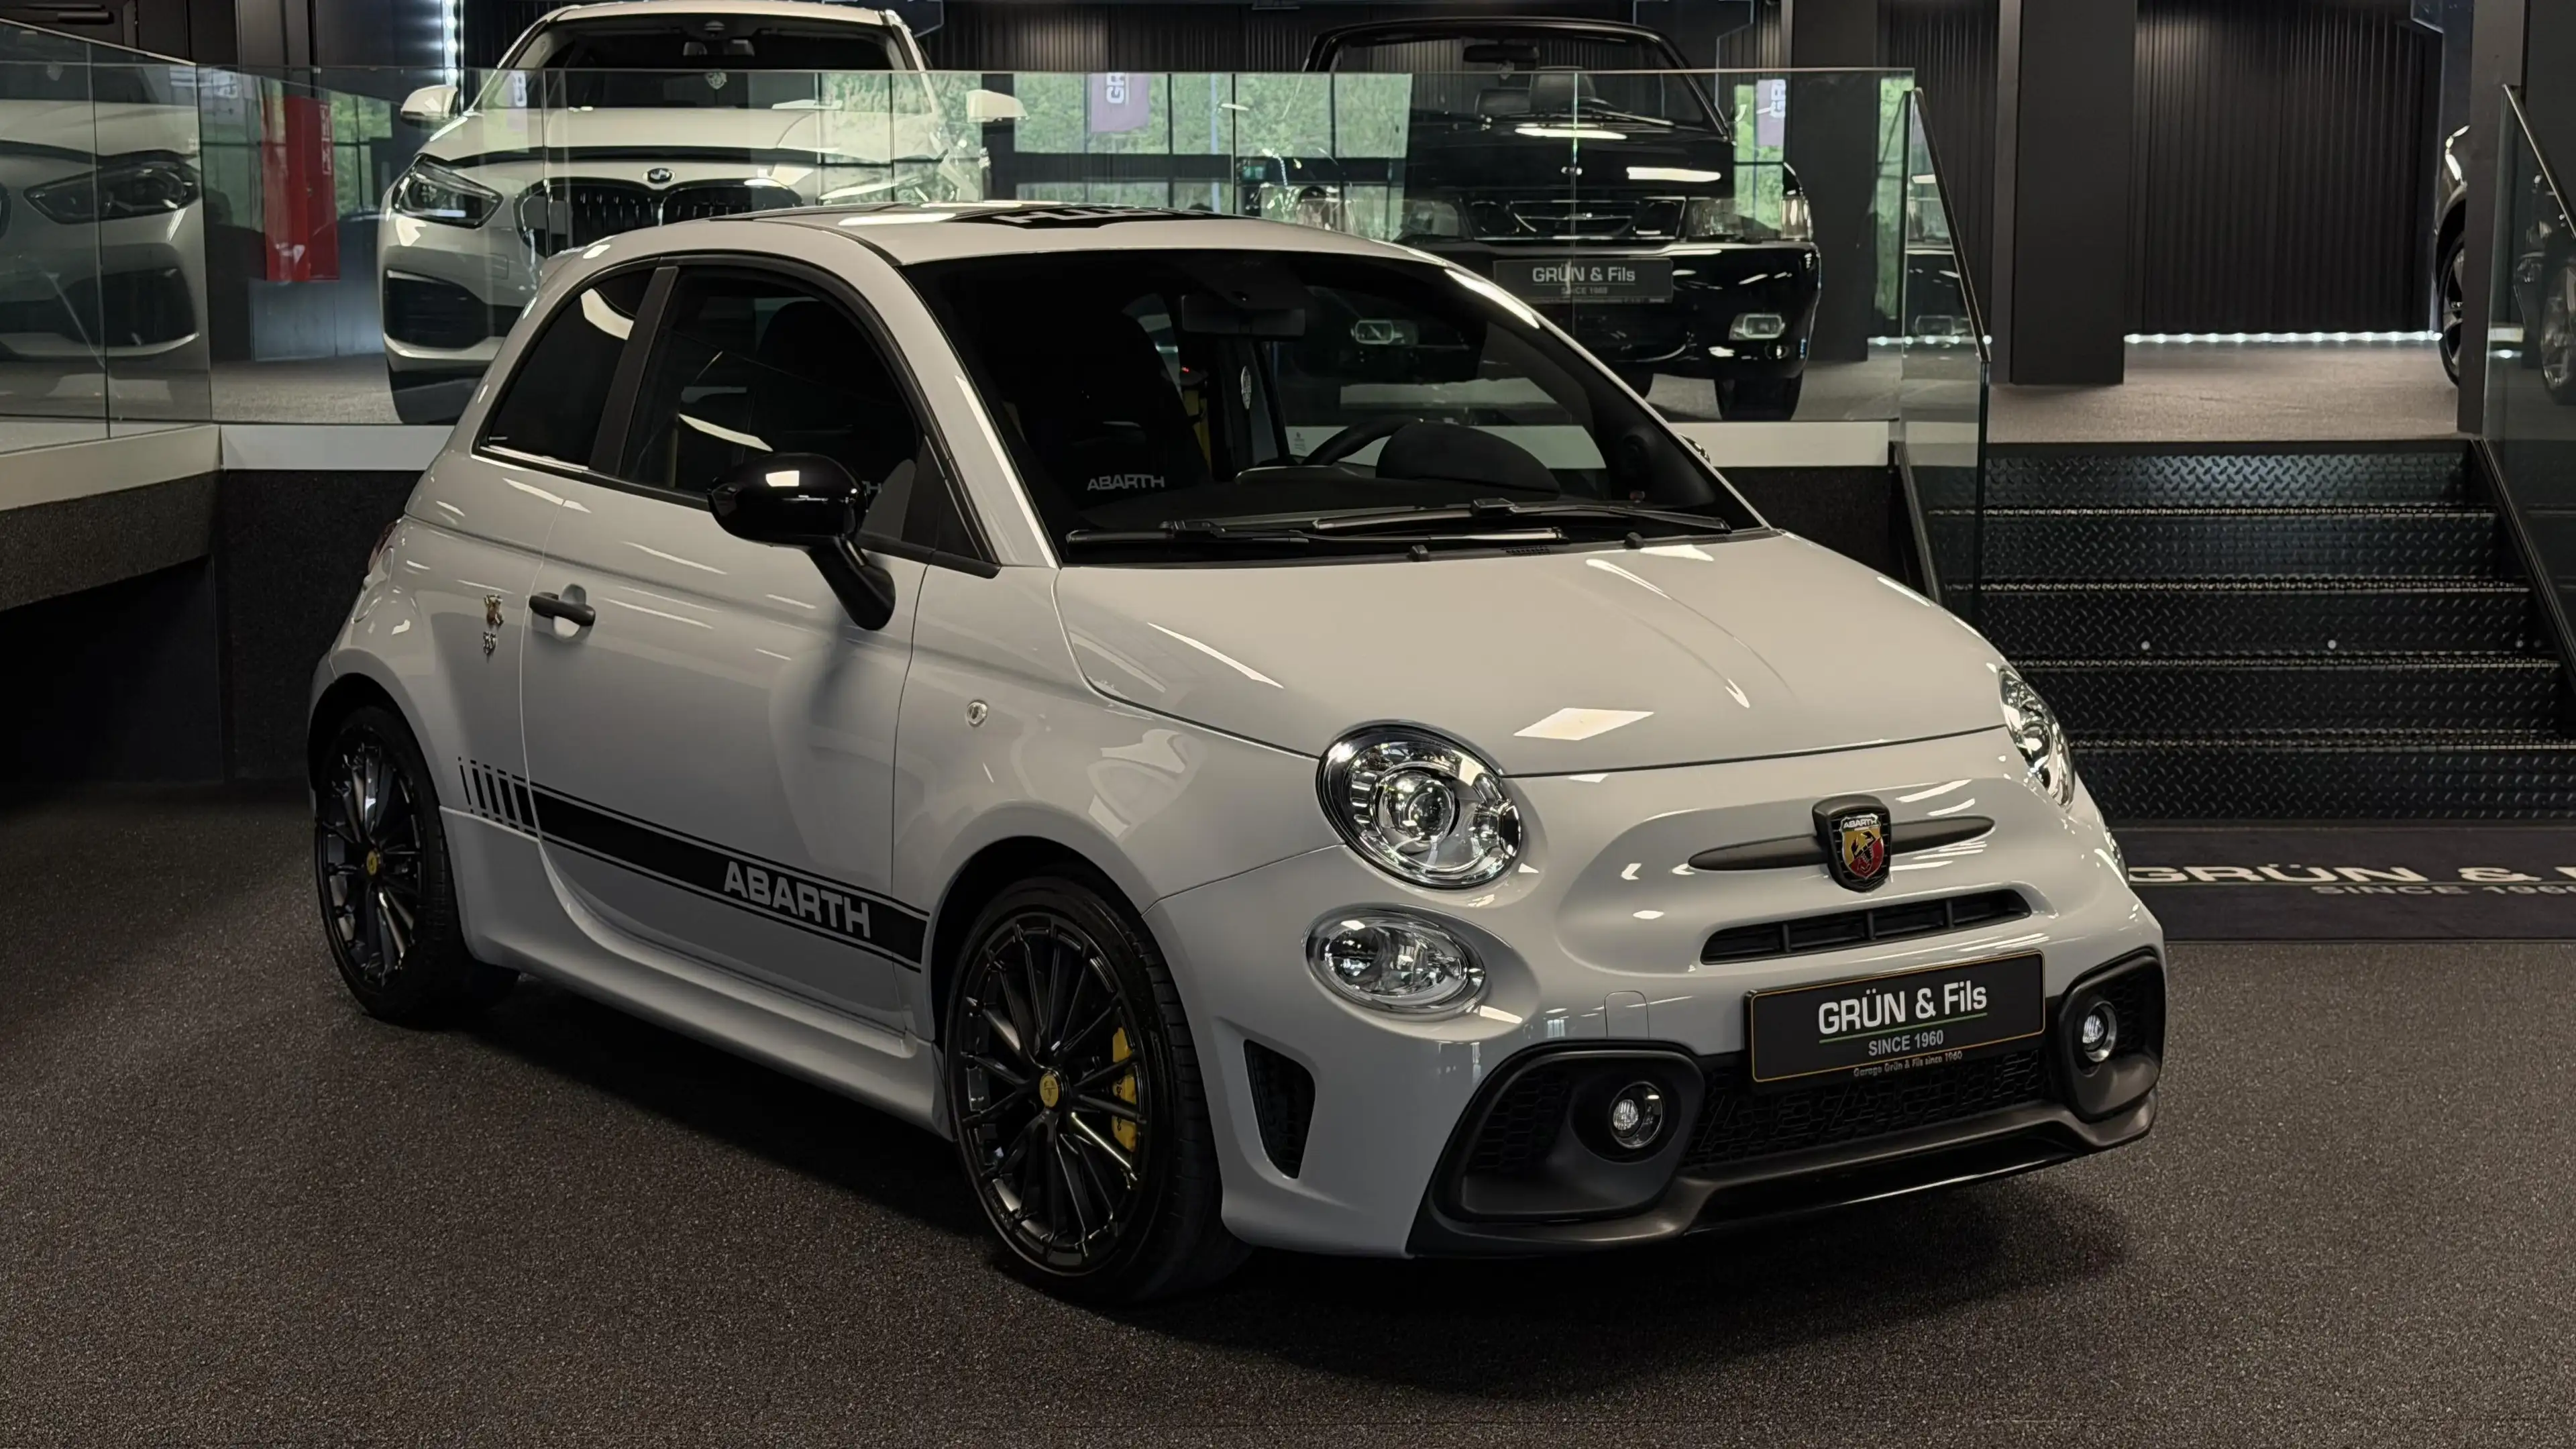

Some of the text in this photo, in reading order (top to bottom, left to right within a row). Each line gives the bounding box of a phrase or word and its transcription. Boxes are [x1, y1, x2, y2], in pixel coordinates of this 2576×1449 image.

[1532, 264, 1635, 282] GRÜN & Fils
[1087, 474, 1165, 491] ABARTH
[1843, 818, 1878, 828] ABARTH
[2128, 864, 2430, 882] GRÜN
[2457, 867, 2544, 883] &
[2311, 885, 2470, 894] SINCE
[723, 861, 871, 939] ABARTH
[1818, 979, 1988, 1035] GRÜN & Fils
[1868, 1030, 1945, 1057] SINCE 1960
[1853, 1051, 1963, 1077] Garage Grün & Fils since 1960
